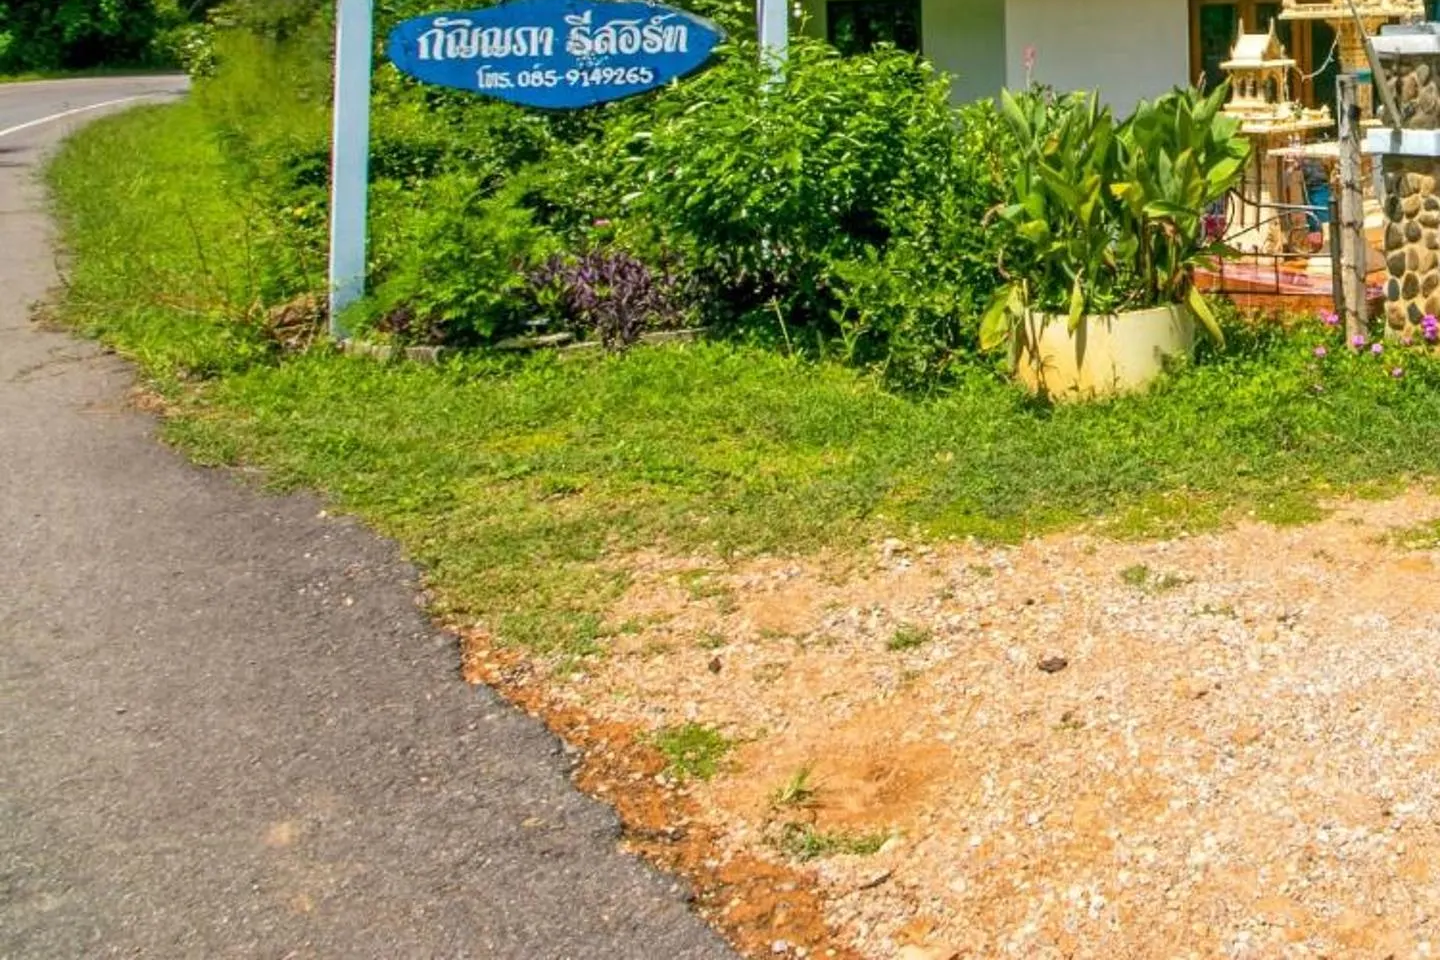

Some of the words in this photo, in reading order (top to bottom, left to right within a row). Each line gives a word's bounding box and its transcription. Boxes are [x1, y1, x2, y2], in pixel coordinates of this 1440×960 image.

[564, 10, 688, 56] รีสอร์ท
[476, 65, 515, 88] โทร.
[517, 66, 654, 87] 085-9149265
